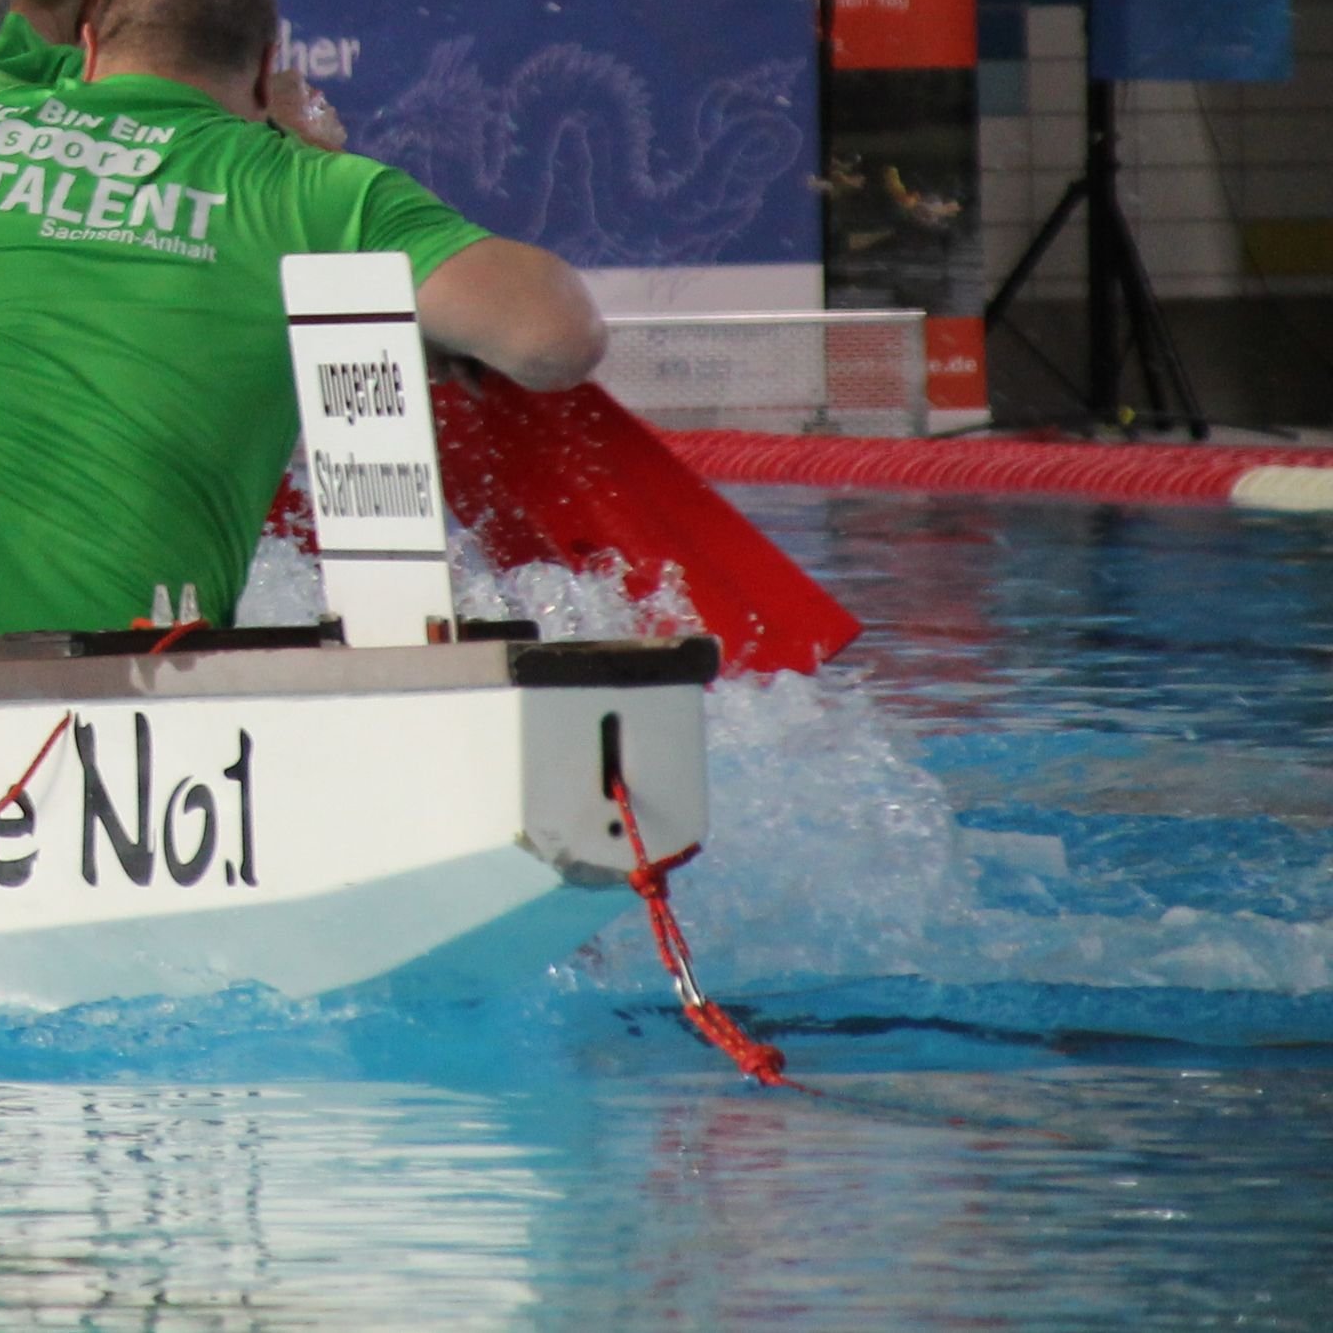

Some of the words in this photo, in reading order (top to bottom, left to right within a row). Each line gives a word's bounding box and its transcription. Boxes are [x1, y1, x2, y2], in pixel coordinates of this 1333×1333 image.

[39, 217, 219, 262] Sachsen-Anhalt
[318, 349, 406, 426] ungerade
[315, 448, 435, 519] Startnummer
[74, 711, 259, 889] No.1
